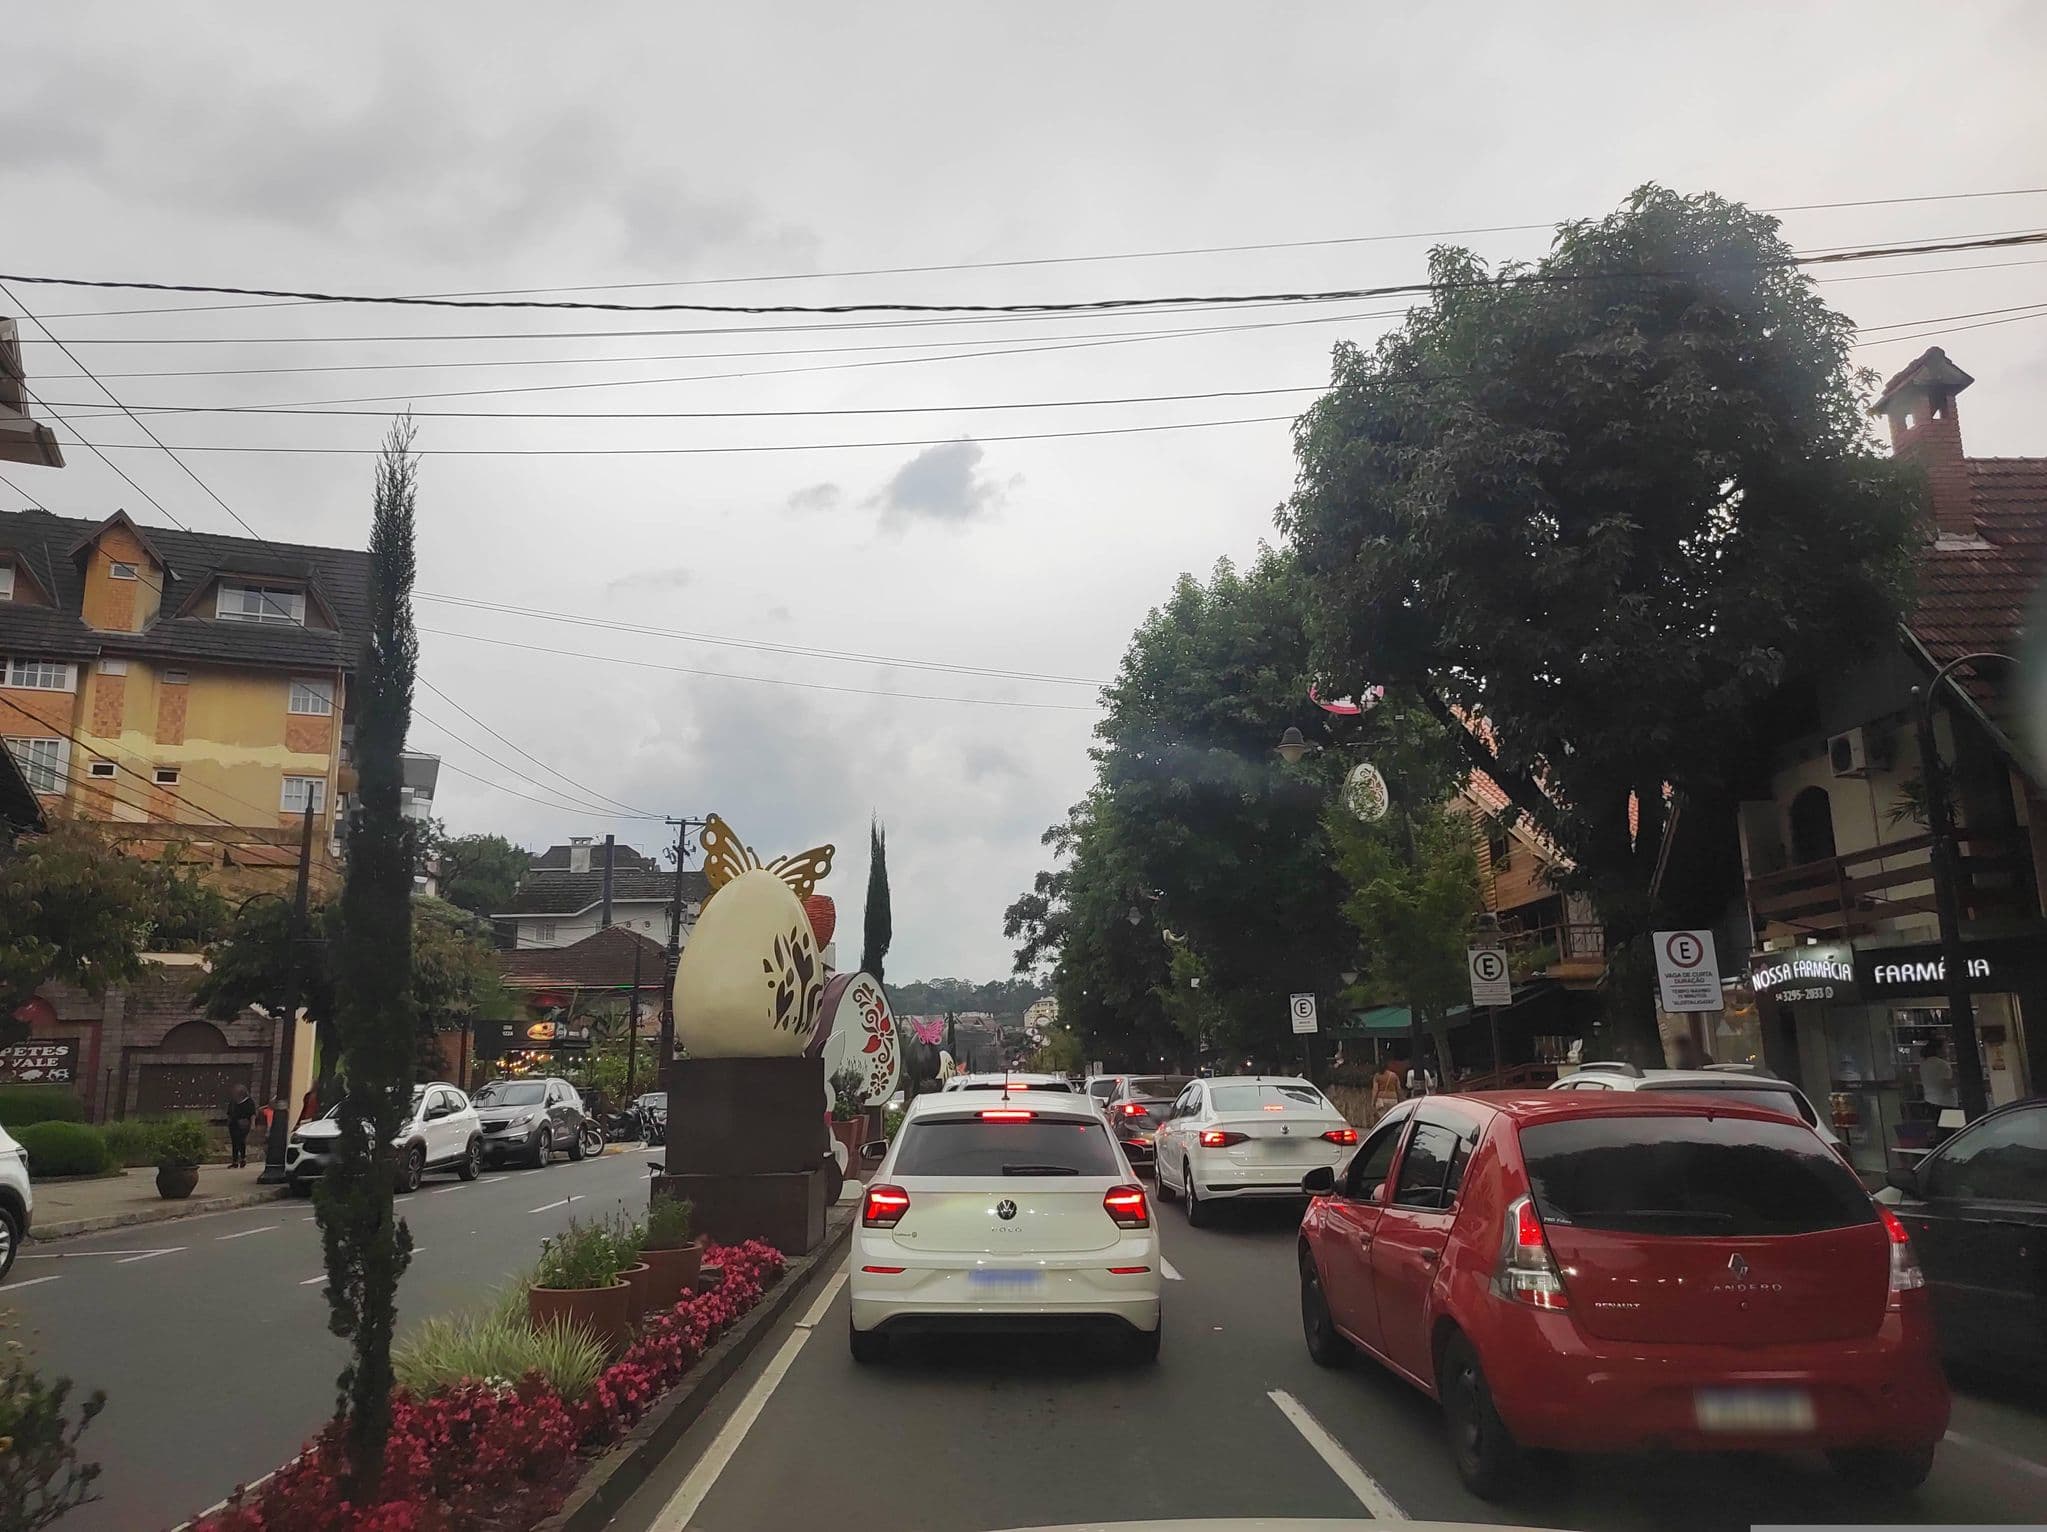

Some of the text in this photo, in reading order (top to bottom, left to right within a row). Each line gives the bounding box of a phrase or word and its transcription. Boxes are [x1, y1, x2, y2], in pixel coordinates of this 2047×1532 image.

[1679, 941, 1692, 960] E
[1482, 957, 1496, 976] E
[1751, 959, 1853, 992] NOSSA FARMÁCIA
[1874, 955, 1990, 984] FARMÁIA
[1299, 1002, 1308, 1014] E
[12, 1057, 59, 1068] VALE
